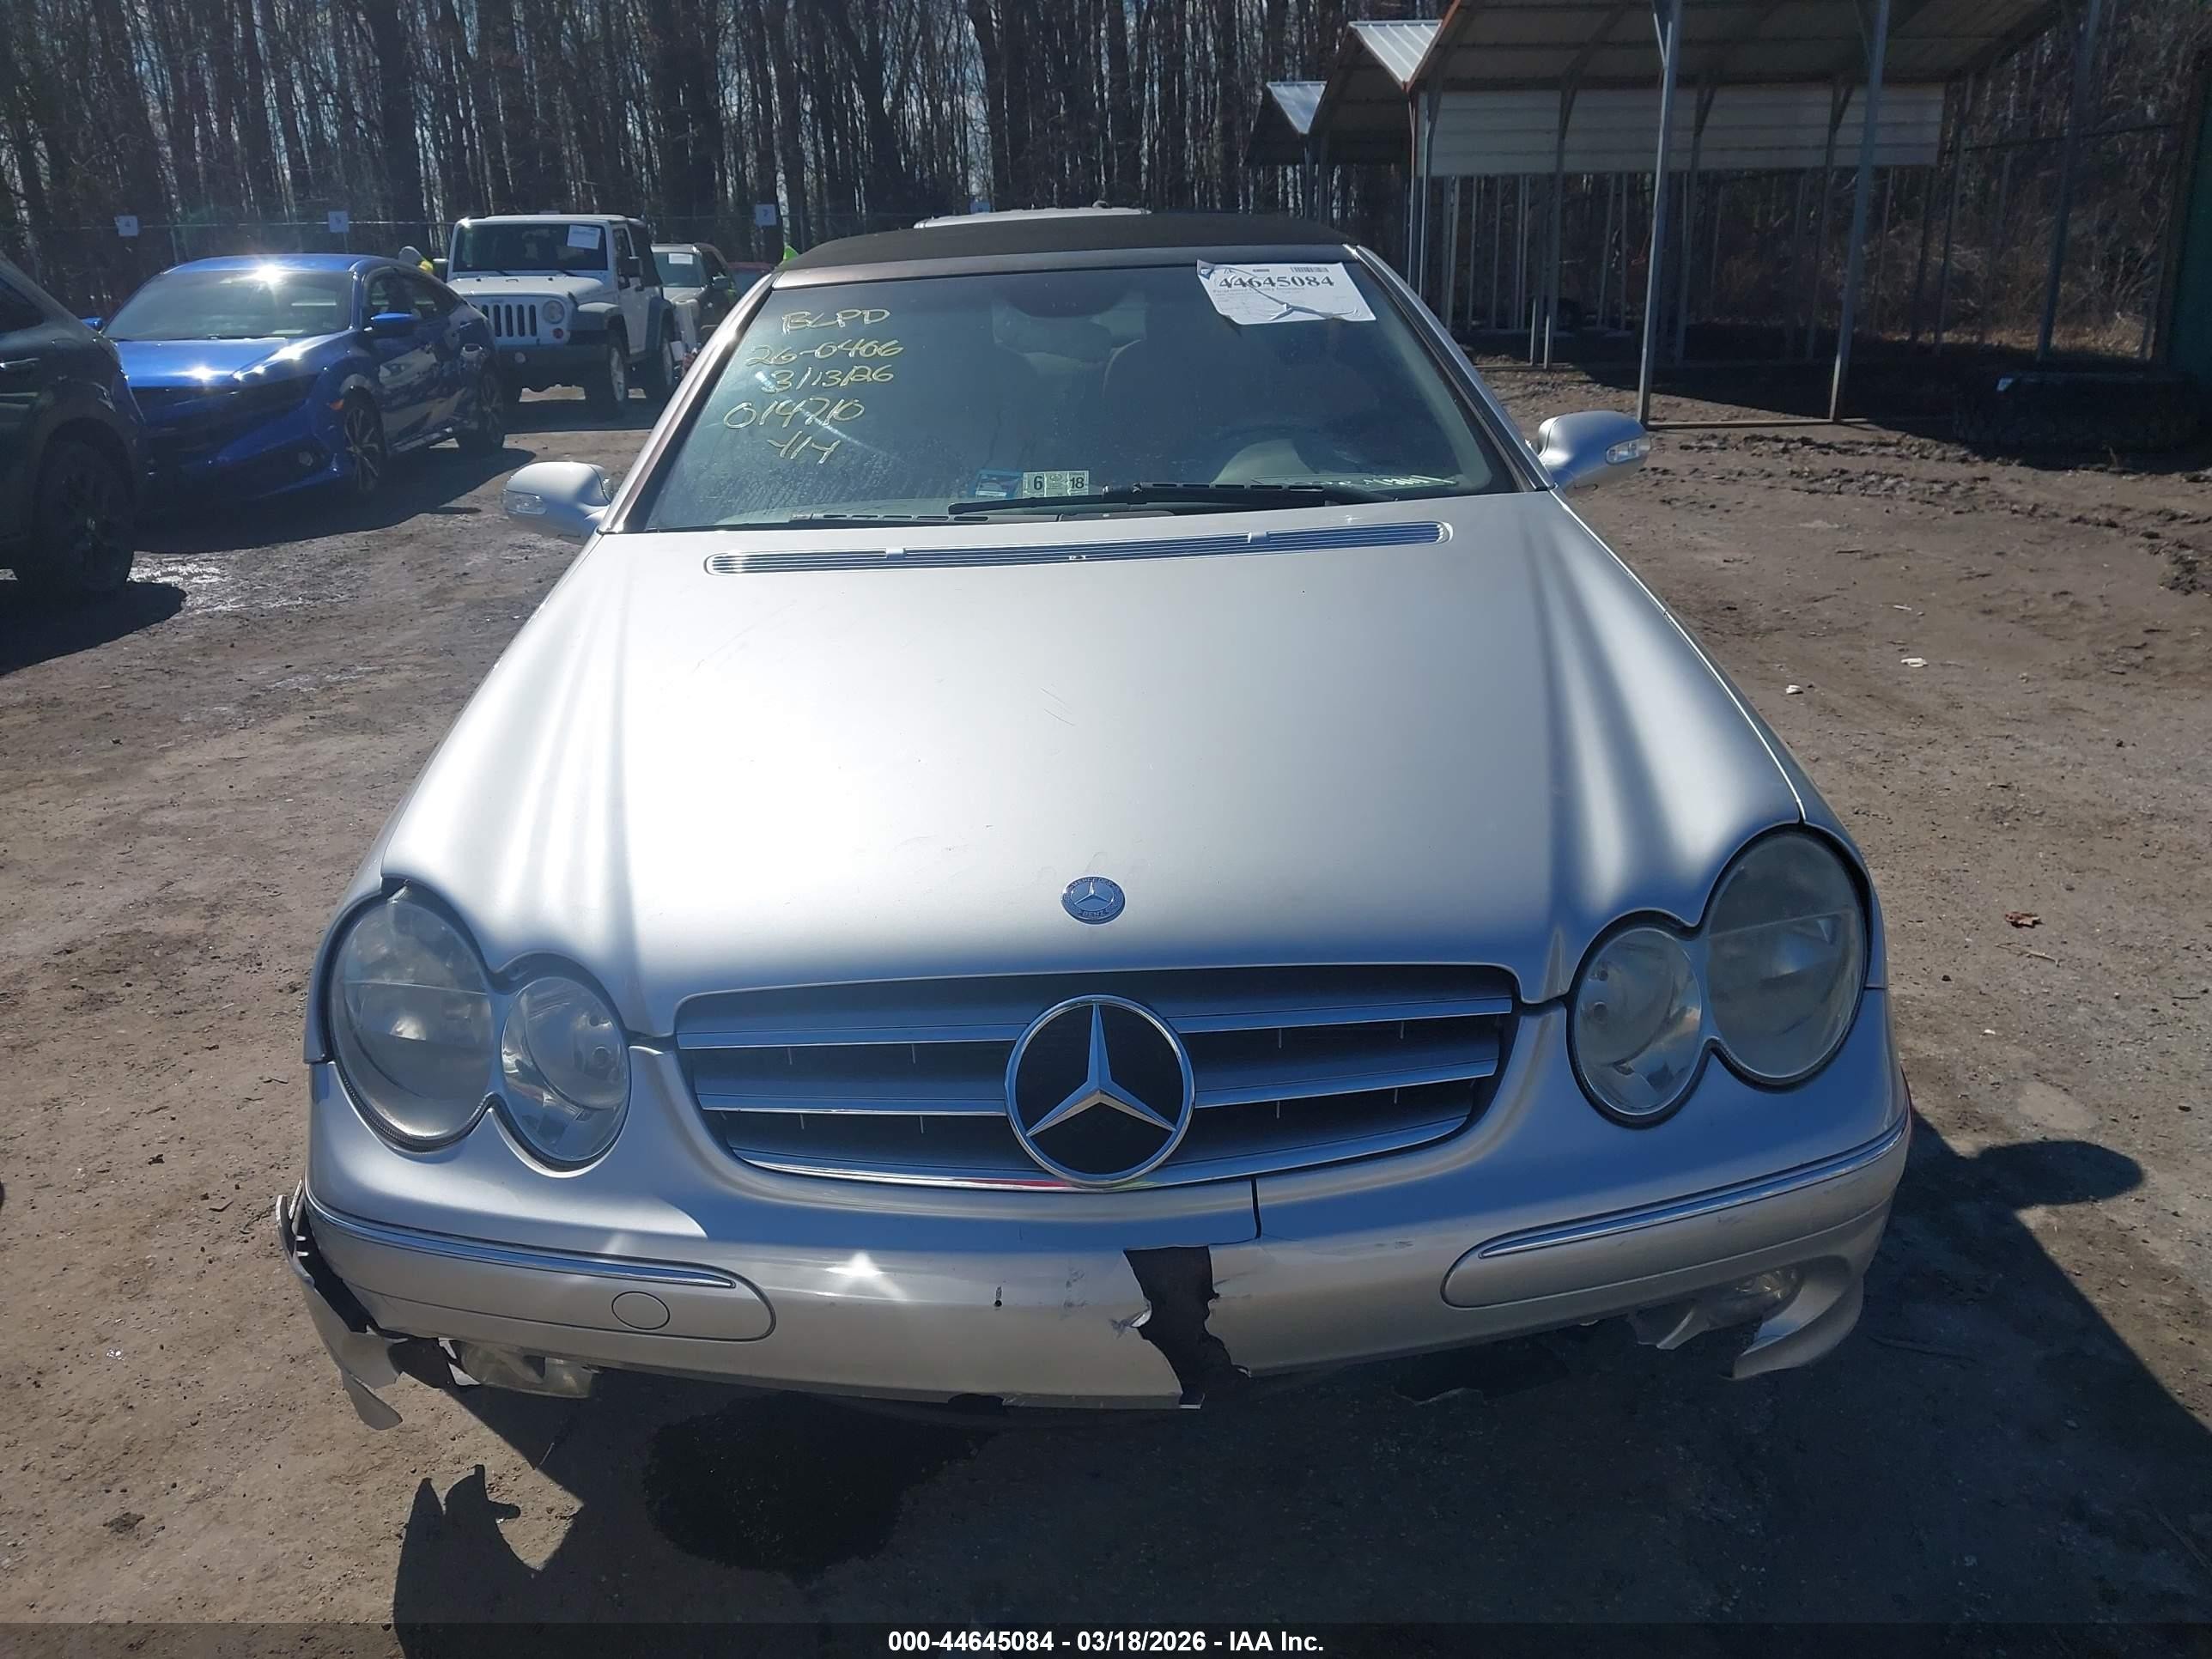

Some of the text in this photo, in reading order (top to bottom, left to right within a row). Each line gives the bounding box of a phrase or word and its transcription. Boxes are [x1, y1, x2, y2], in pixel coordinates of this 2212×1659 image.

[1218, 276, 1334, 289] 44645084
[1033, 475, 1043, 491] 6
[1069, 477, 1085, 489] 18
